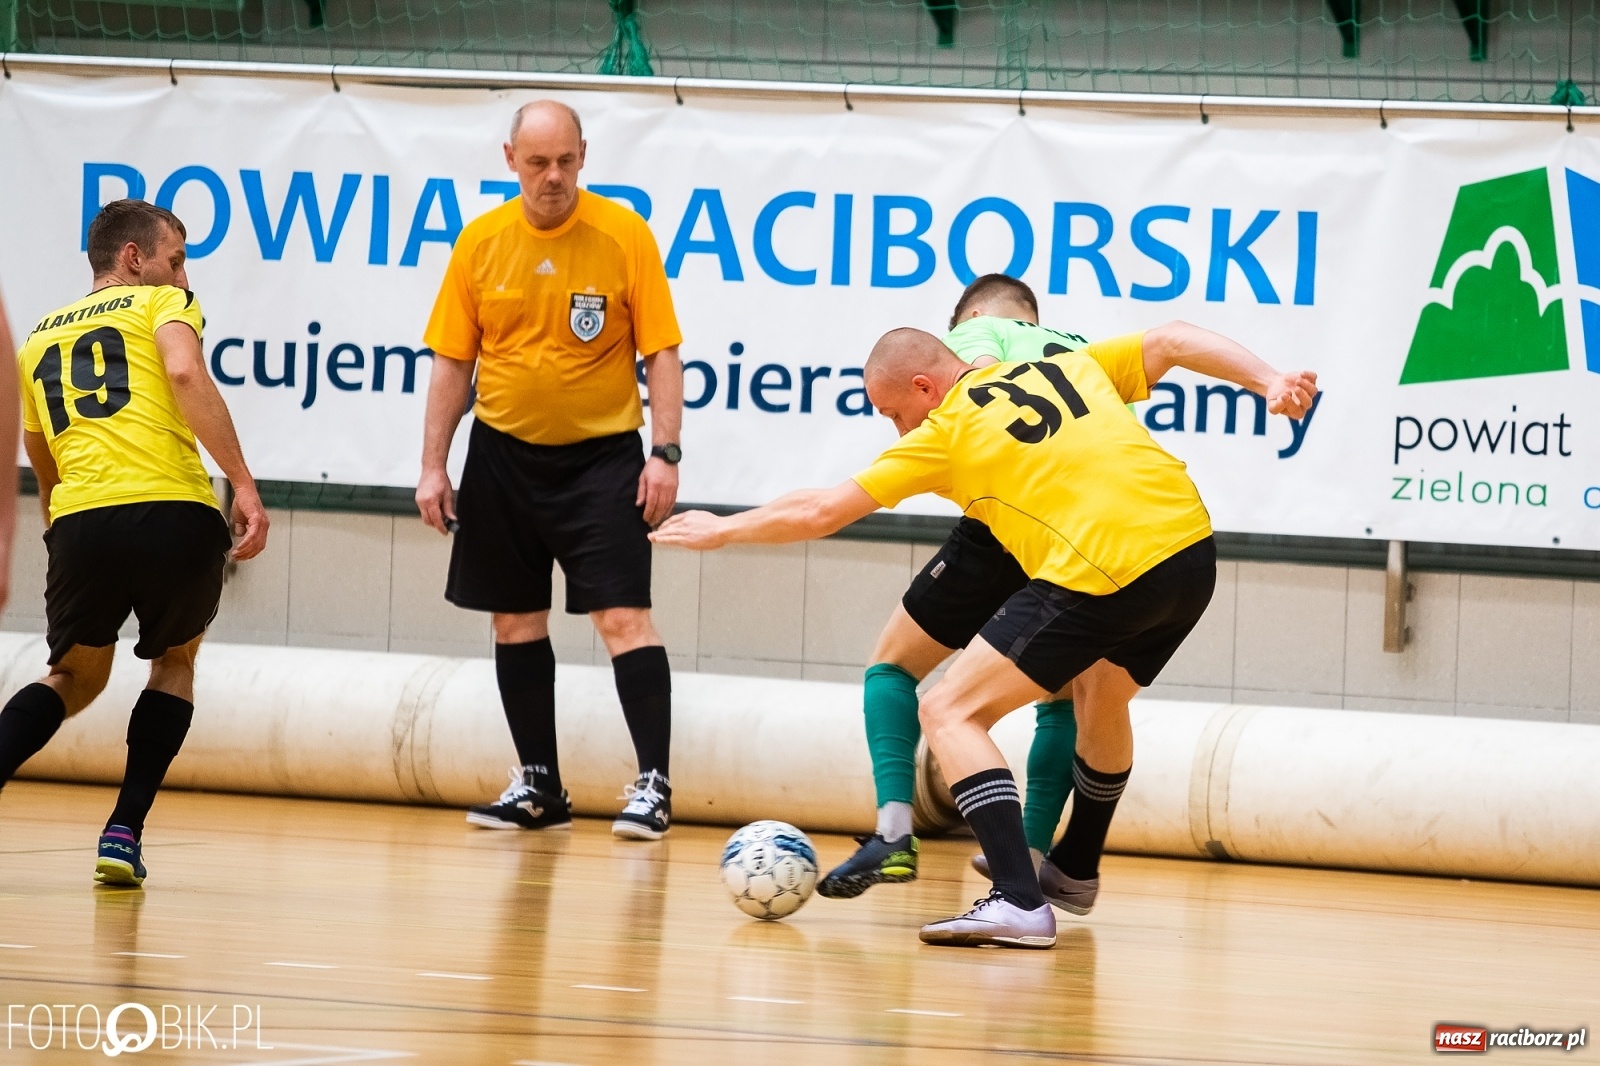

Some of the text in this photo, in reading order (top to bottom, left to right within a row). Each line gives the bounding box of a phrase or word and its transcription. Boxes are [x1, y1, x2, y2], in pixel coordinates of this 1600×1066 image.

[33, 326, 131, 437] 19
[968, 361, 1090, 444] 37
[1394, 405, 1572, 465] powiat
[1391, 470, 1548, 508] zielona
